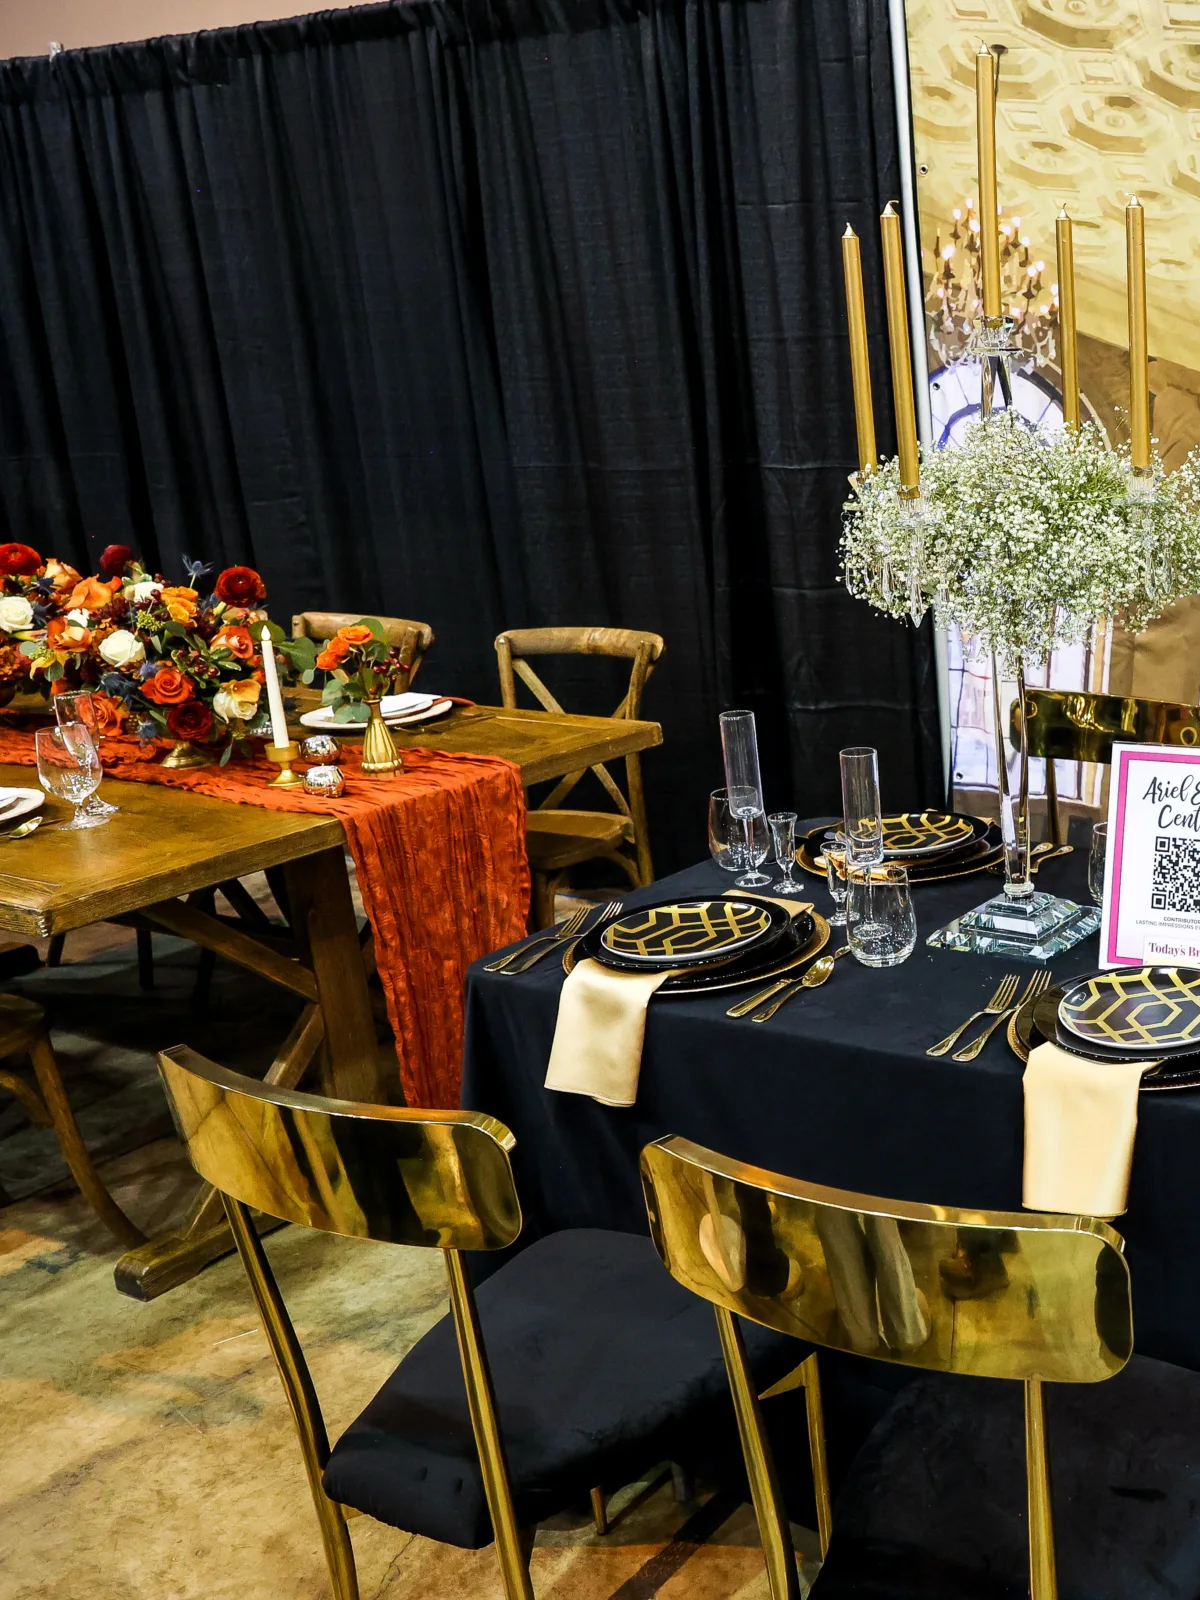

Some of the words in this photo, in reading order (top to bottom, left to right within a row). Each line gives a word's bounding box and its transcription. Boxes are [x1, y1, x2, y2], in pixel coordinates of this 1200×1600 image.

[1142, 774, 1194, 804] Ariel
[1158, 921, 1194, 930] IMPRESSIONS
[1148, 942, 1186, 957] Today's
